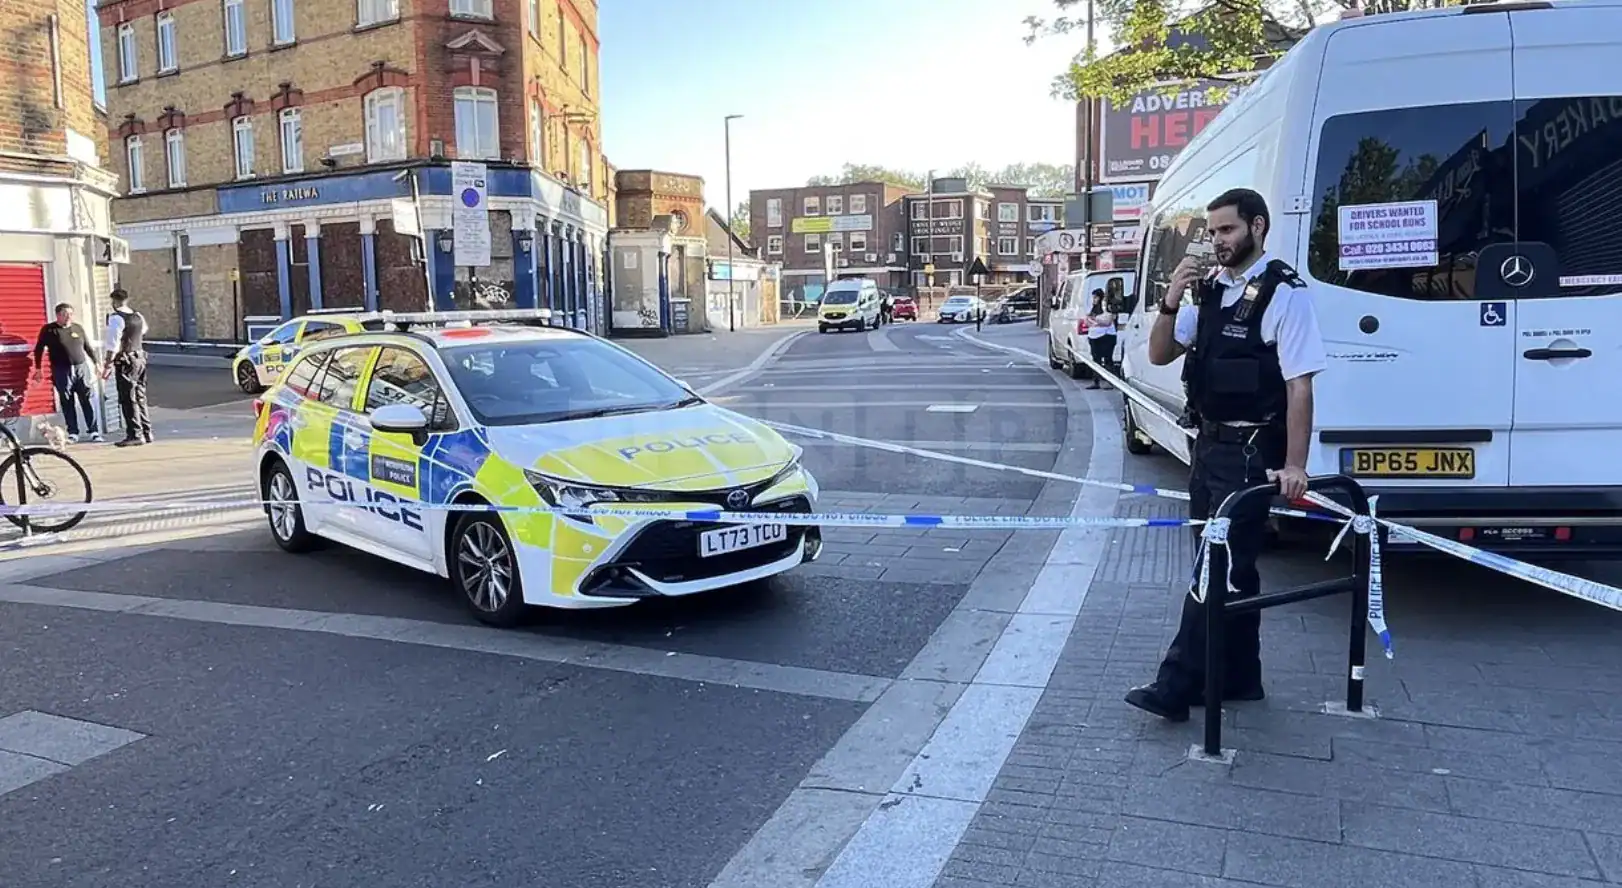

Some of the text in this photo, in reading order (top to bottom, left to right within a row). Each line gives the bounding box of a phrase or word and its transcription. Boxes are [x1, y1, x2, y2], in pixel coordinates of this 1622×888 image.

[261, 191, 277, 203] THE
[1114, 187, 1147, 199] MOT
[1350, 206, 1425, 220] DRIVERS WANTED
[1349, 217, 1426, 231] FOR SCHOOL RUNS
[616, 433, 757, 460] POLICE
[1357, 452, 1470, 471] BP65 JNX
[390, 471, 411, 483] POLICE
[306, 466, 424, 531] POLICE
[708, 526, 750, 553] LT73
